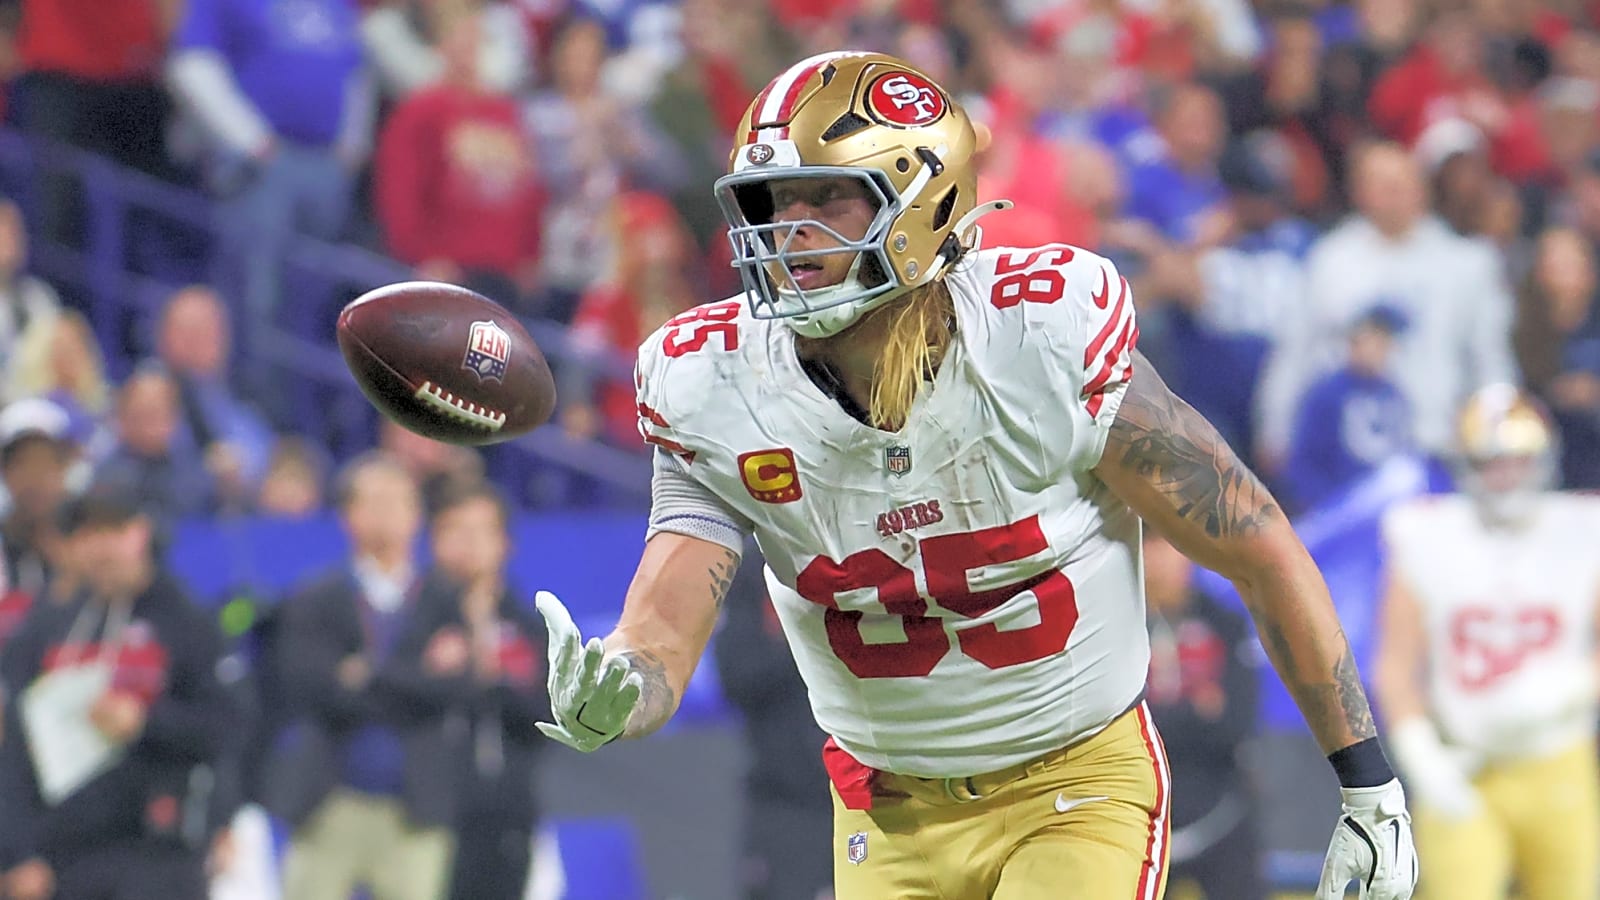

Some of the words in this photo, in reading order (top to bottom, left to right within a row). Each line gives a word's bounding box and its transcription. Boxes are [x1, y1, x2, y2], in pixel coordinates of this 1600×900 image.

[881, 76, 935, 121] SF
[990, 247, 1075, 310] 85
[476, 328, 506, 360] NFL
[663, 302, 741, 358] 85
[743, 453, 794, 491] C
[889, 457, 910, 471] NFL
[877, 499, 944, 536] 49ERS
[796, 514, 1079, 679] 85
[850, 845, 865, 858] NFL
